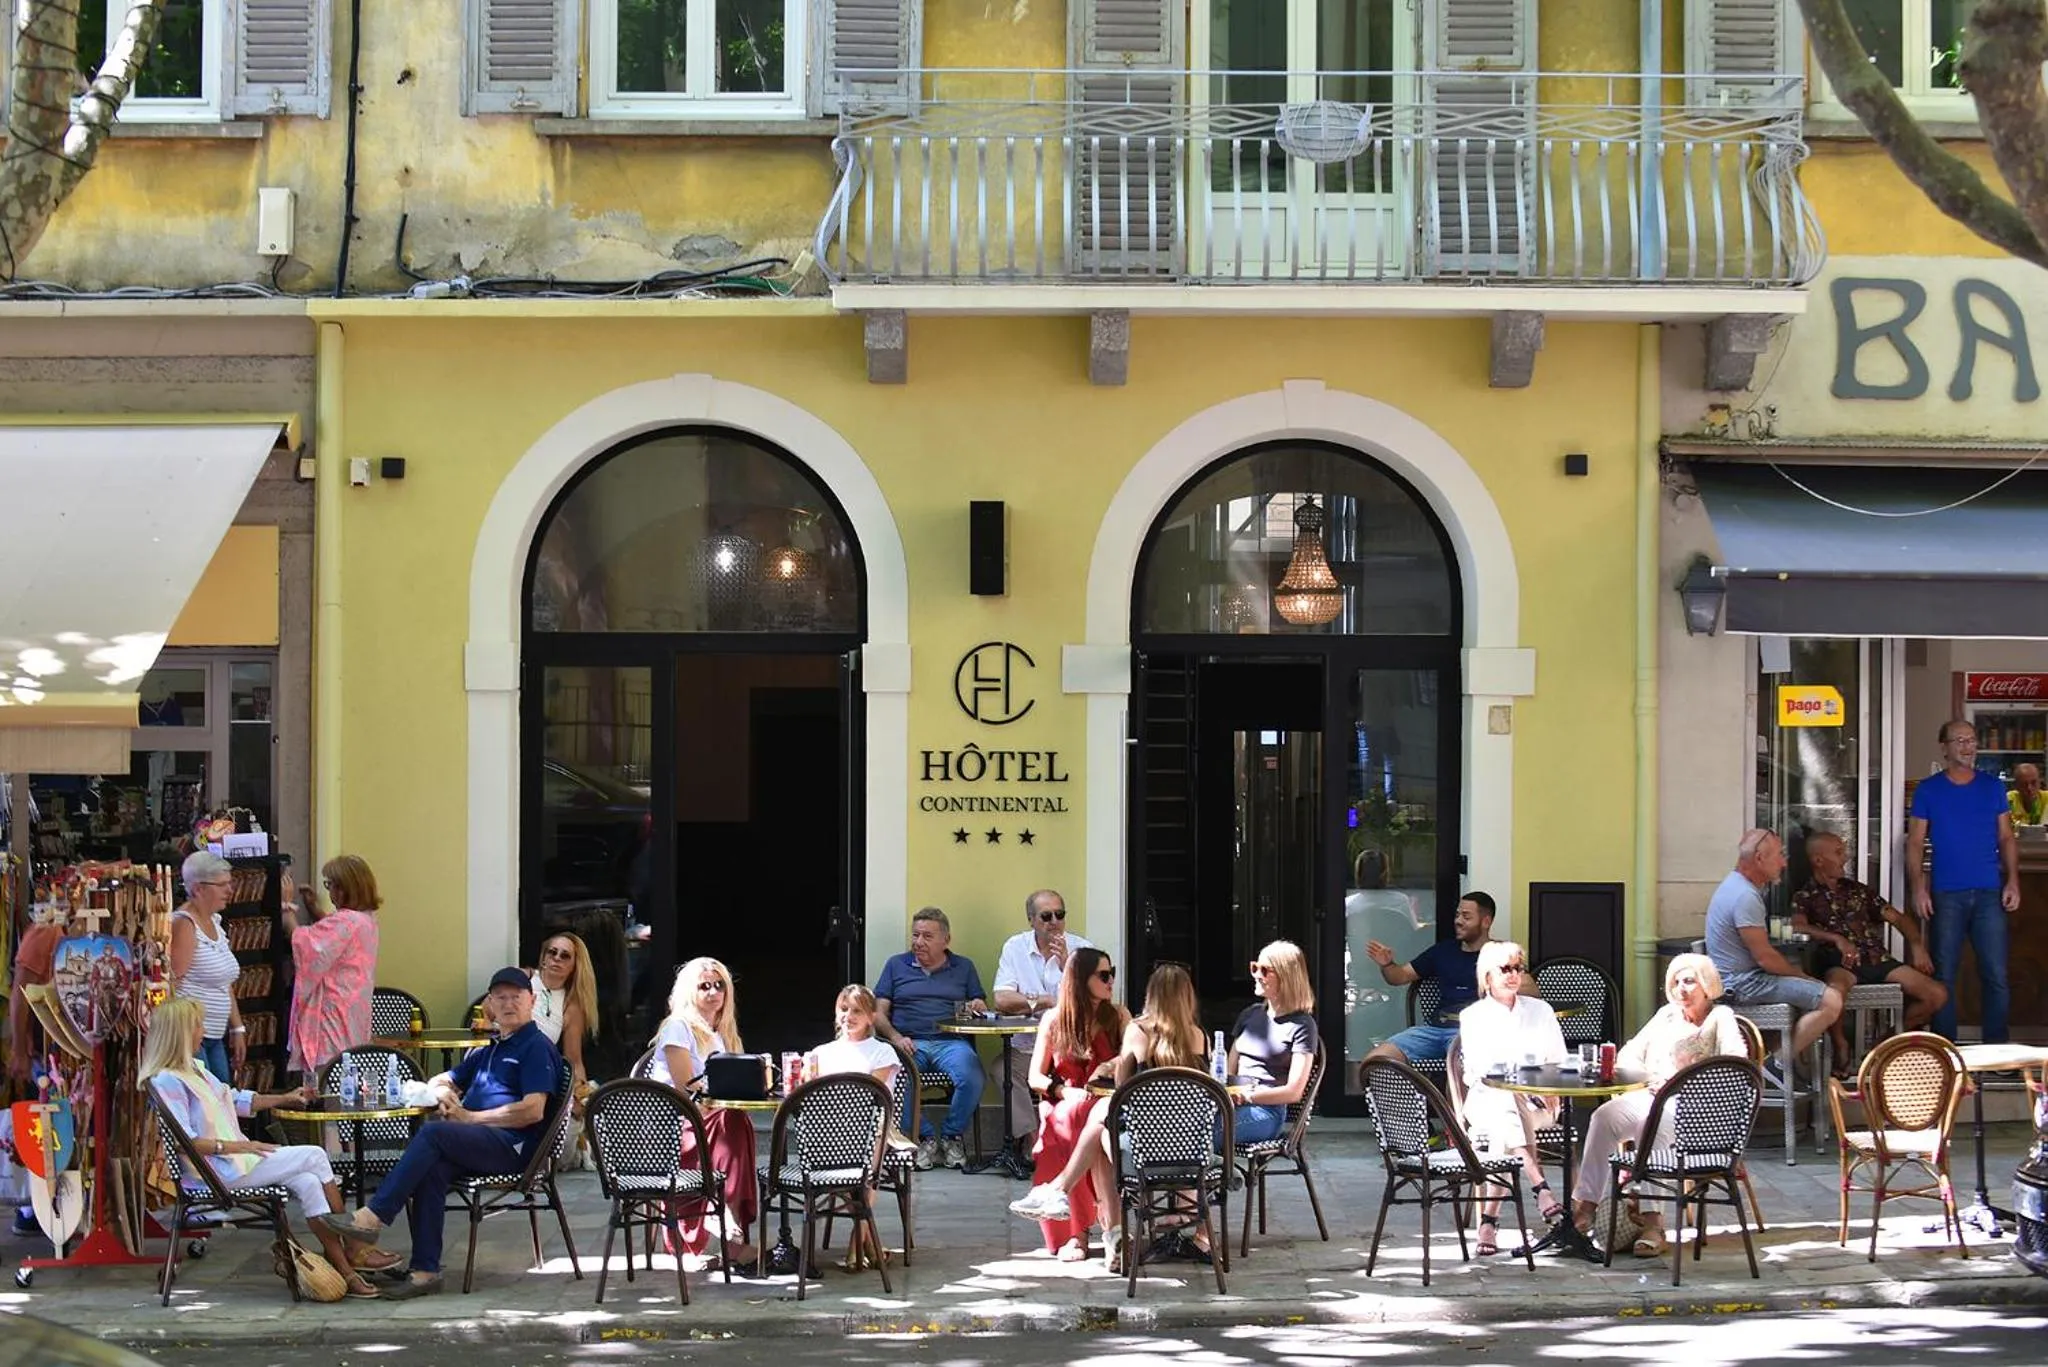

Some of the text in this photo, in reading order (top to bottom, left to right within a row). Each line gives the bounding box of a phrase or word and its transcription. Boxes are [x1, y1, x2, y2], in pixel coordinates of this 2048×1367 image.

[1979, 676, 2041, 696] Coca-Cola
[1785, 699, 1821, 715] pago
[920, 742, 1069, 782] HÔTEL
[920, 796, 1069, 813] CONTINENTAL
